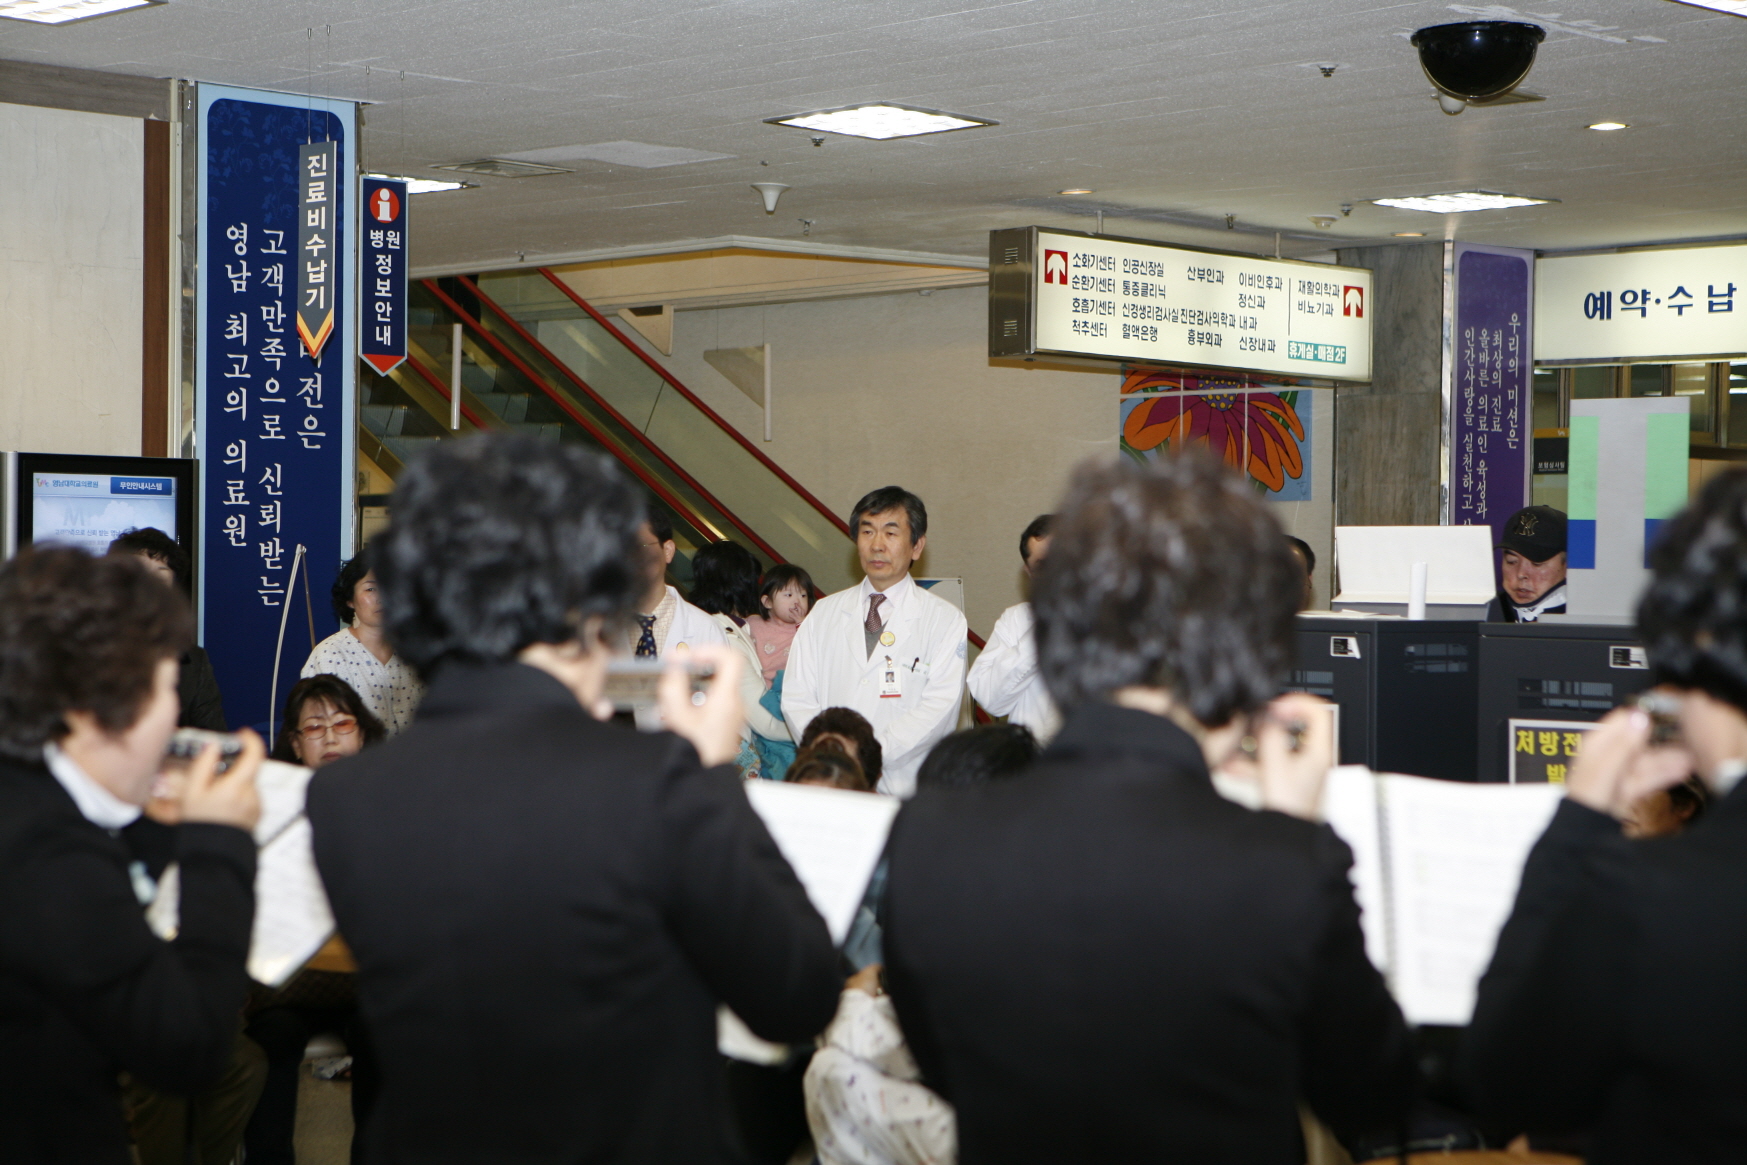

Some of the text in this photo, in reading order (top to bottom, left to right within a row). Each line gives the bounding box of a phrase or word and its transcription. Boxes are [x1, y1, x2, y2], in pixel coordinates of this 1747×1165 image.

[305, 153, 327, 310] 진료비수납기
[370, 229, 400, 250] 병원
[1072, 253, 1116, 272] 소화기센터
[1123, 258, 1164, 277] 인공신장실
[1072, 275, 1116, 294] 순환기센터
[1187, 266, 1224, 285] 산부인과
[1239, 272, 1283, 292] 이비인후과
[1122, 280, 1166, 299] 통증클리닉
[1298, 280, 1340, 299] 재활의학과
[375, 254, 393, 346] 정보안내
[1072, 297, 1116, 317] 호흡기센터
[1238, 293, 1265, 310] 정신과
[1298, 300, 1334, 317] 비뇨기과
[1122, 302, 1179, 323] 신경생리검사실
[1180, 308, 1236, 329] 진단검사의학과
[259, 229, 287, 440] 고객만족으로
[1072, 319, 1107, 338] 척추센터
[1122, 323, 1158, 342] 혈액은행
[1187, 329, 1222, 348] 흉부외과
[1239, 336, 1276, 353] 신장내과
[222, 222, 251, 547] 영남 최고의 의료원
[1463, 326, 1476, 426] 인간사랑을
[1491, 329, 1503, 432] 최상의 진료
[1506, 312, 1521, 450] 우리의 미션은
[1475, 328, 1490, 520] 올바른 의료인 육성과
[1461, 432, 1474, 510] 실천하고
[119, 481, 163, 491] 무인안내시스템
